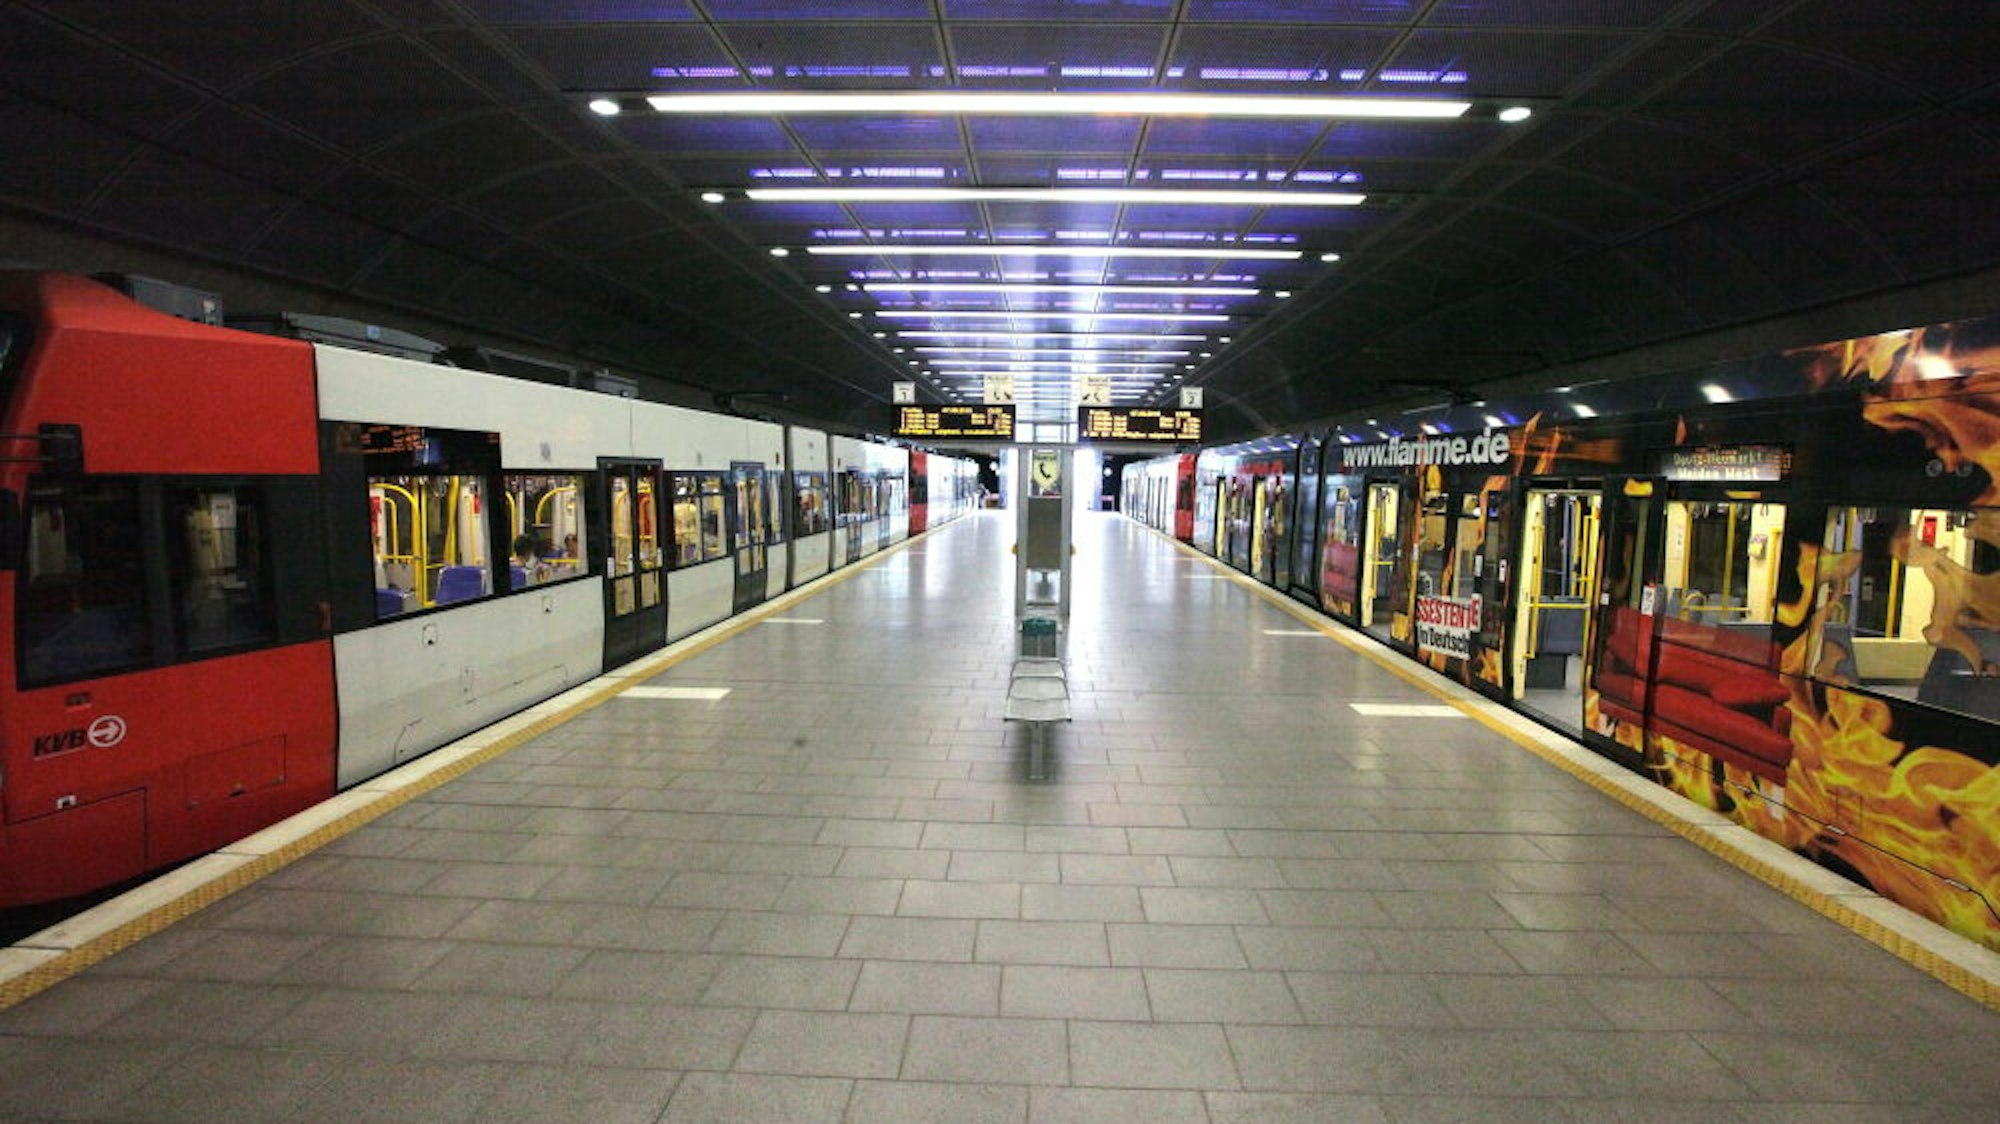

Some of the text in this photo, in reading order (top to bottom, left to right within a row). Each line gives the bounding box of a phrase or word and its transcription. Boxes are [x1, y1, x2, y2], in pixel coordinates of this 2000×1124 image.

[1343, 426, 1510, 467] www.flamme.de
[1725, 466, 1760, 480] West
[33, 729, 87, 758] KVB
